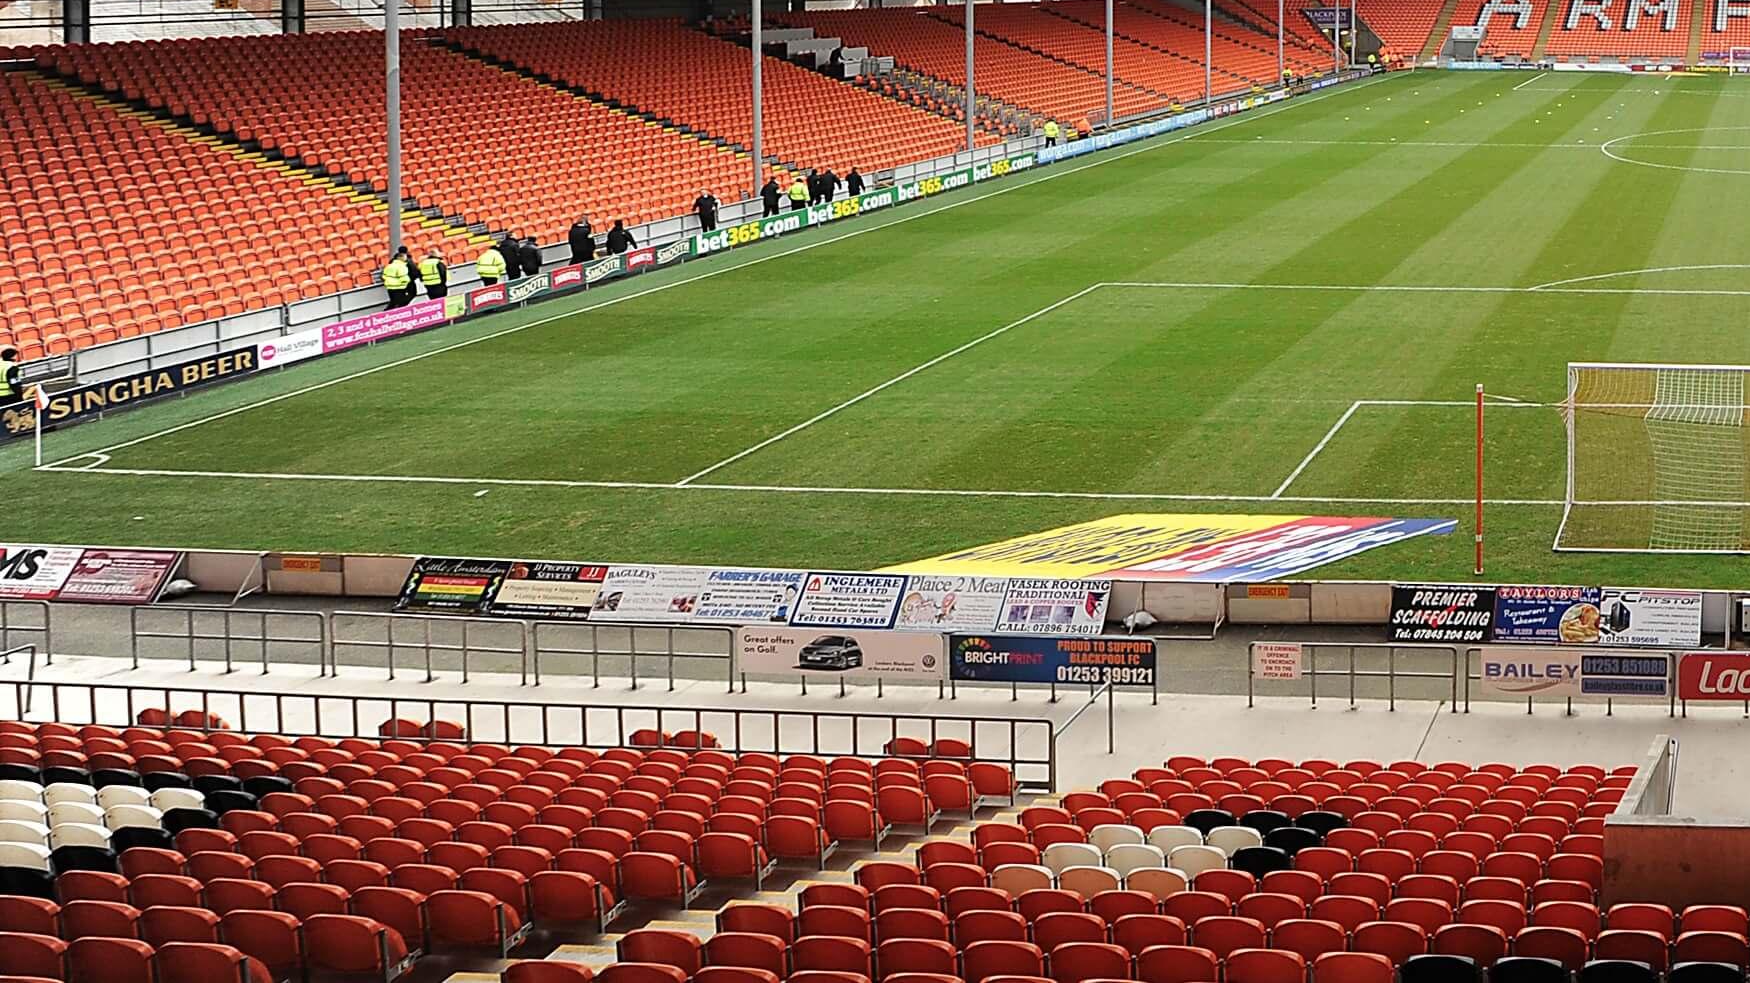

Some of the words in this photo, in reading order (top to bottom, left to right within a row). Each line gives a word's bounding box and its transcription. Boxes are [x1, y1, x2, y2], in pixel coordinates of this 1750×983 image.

[974, 154, 1032, 181] bet365.com
[898, 171, 968, 201] bet365.com
[808, 190, 893, 225] bet365.com
[697, 215, 800, 253] bet365.com
[657, 241, 690, 264] SMOOTH
[586, 259, 620, 282] SMOOTH
[509, 275, 549, 302] SMOOTH
[338, 327, 344, 335] 3
[345, 322, 363, 332] and
[365, 319, 371, 327] 4
[373, 310, 411, 325] bedroom
[414, 303, 441, 315] homes
[50, 372, 175, 419] SINGHA
[182, 351, 253, 385] BEER
[416, 559, 446, 573] Little
[448, 559, 505, 574] Amsterdam
[543, 564, 579, 572] PROPERTY
[587, 568, 597, 577] JJ
[536, 572, 572, 580] SERVICES
[760, 572, 801, 583] GARAGE
[824, 576, 900, 588] INGLEMERE
[908, 576, 952, 592] Plaice
[957, 579, 967, 593] 2
[967, 578, 1006, 594] Meat
[1011, 580, 1048, 589] VASEK
[1052, 581, 1110, 591] ROOFING
[1009, 590, 1085, 600] TRADITIONAL
[1411, 591, 1478, 607] PREMIER
[1501, 588, 1581, 599] TAYLORS
[1602, 591, 1640, 603] PC
[1639, 597, 1700, 605] PITSTOP
[711, 609, 740, 617] 01253
[819, 616, 847, 624] 01253
[1392, 609, 1490, 626] SCAFFOLDING
[999, 623, 1030, 632] CALL:
[1033, 624, 1062, 632] 07896
[1065, 624, 1101, 633] 754017
[1395, 628, 1411, 639] Tel:
[1413, 629, 1443, 639] 07845
[744, 634, 769, 644] Great
[770, 635, 795, 645] offers
[1058, 640, 1091, 652] PROUD
[1093, 641, 1105, 652] TO
[1107, 641, 1152, 653] SUPPORT
[755, 645, 777, 655] Golf.
[1070, 653, 1125, 664] BLACKPOOL
[1128, 654, 1139, 664] FC
[1583, 658, 1619, 673] 01253
[1057, 666, 1099, 682] 01253
[1102, 667, 1152, 683] 399121
[1485, 662, 1579, 679] BAILEY
